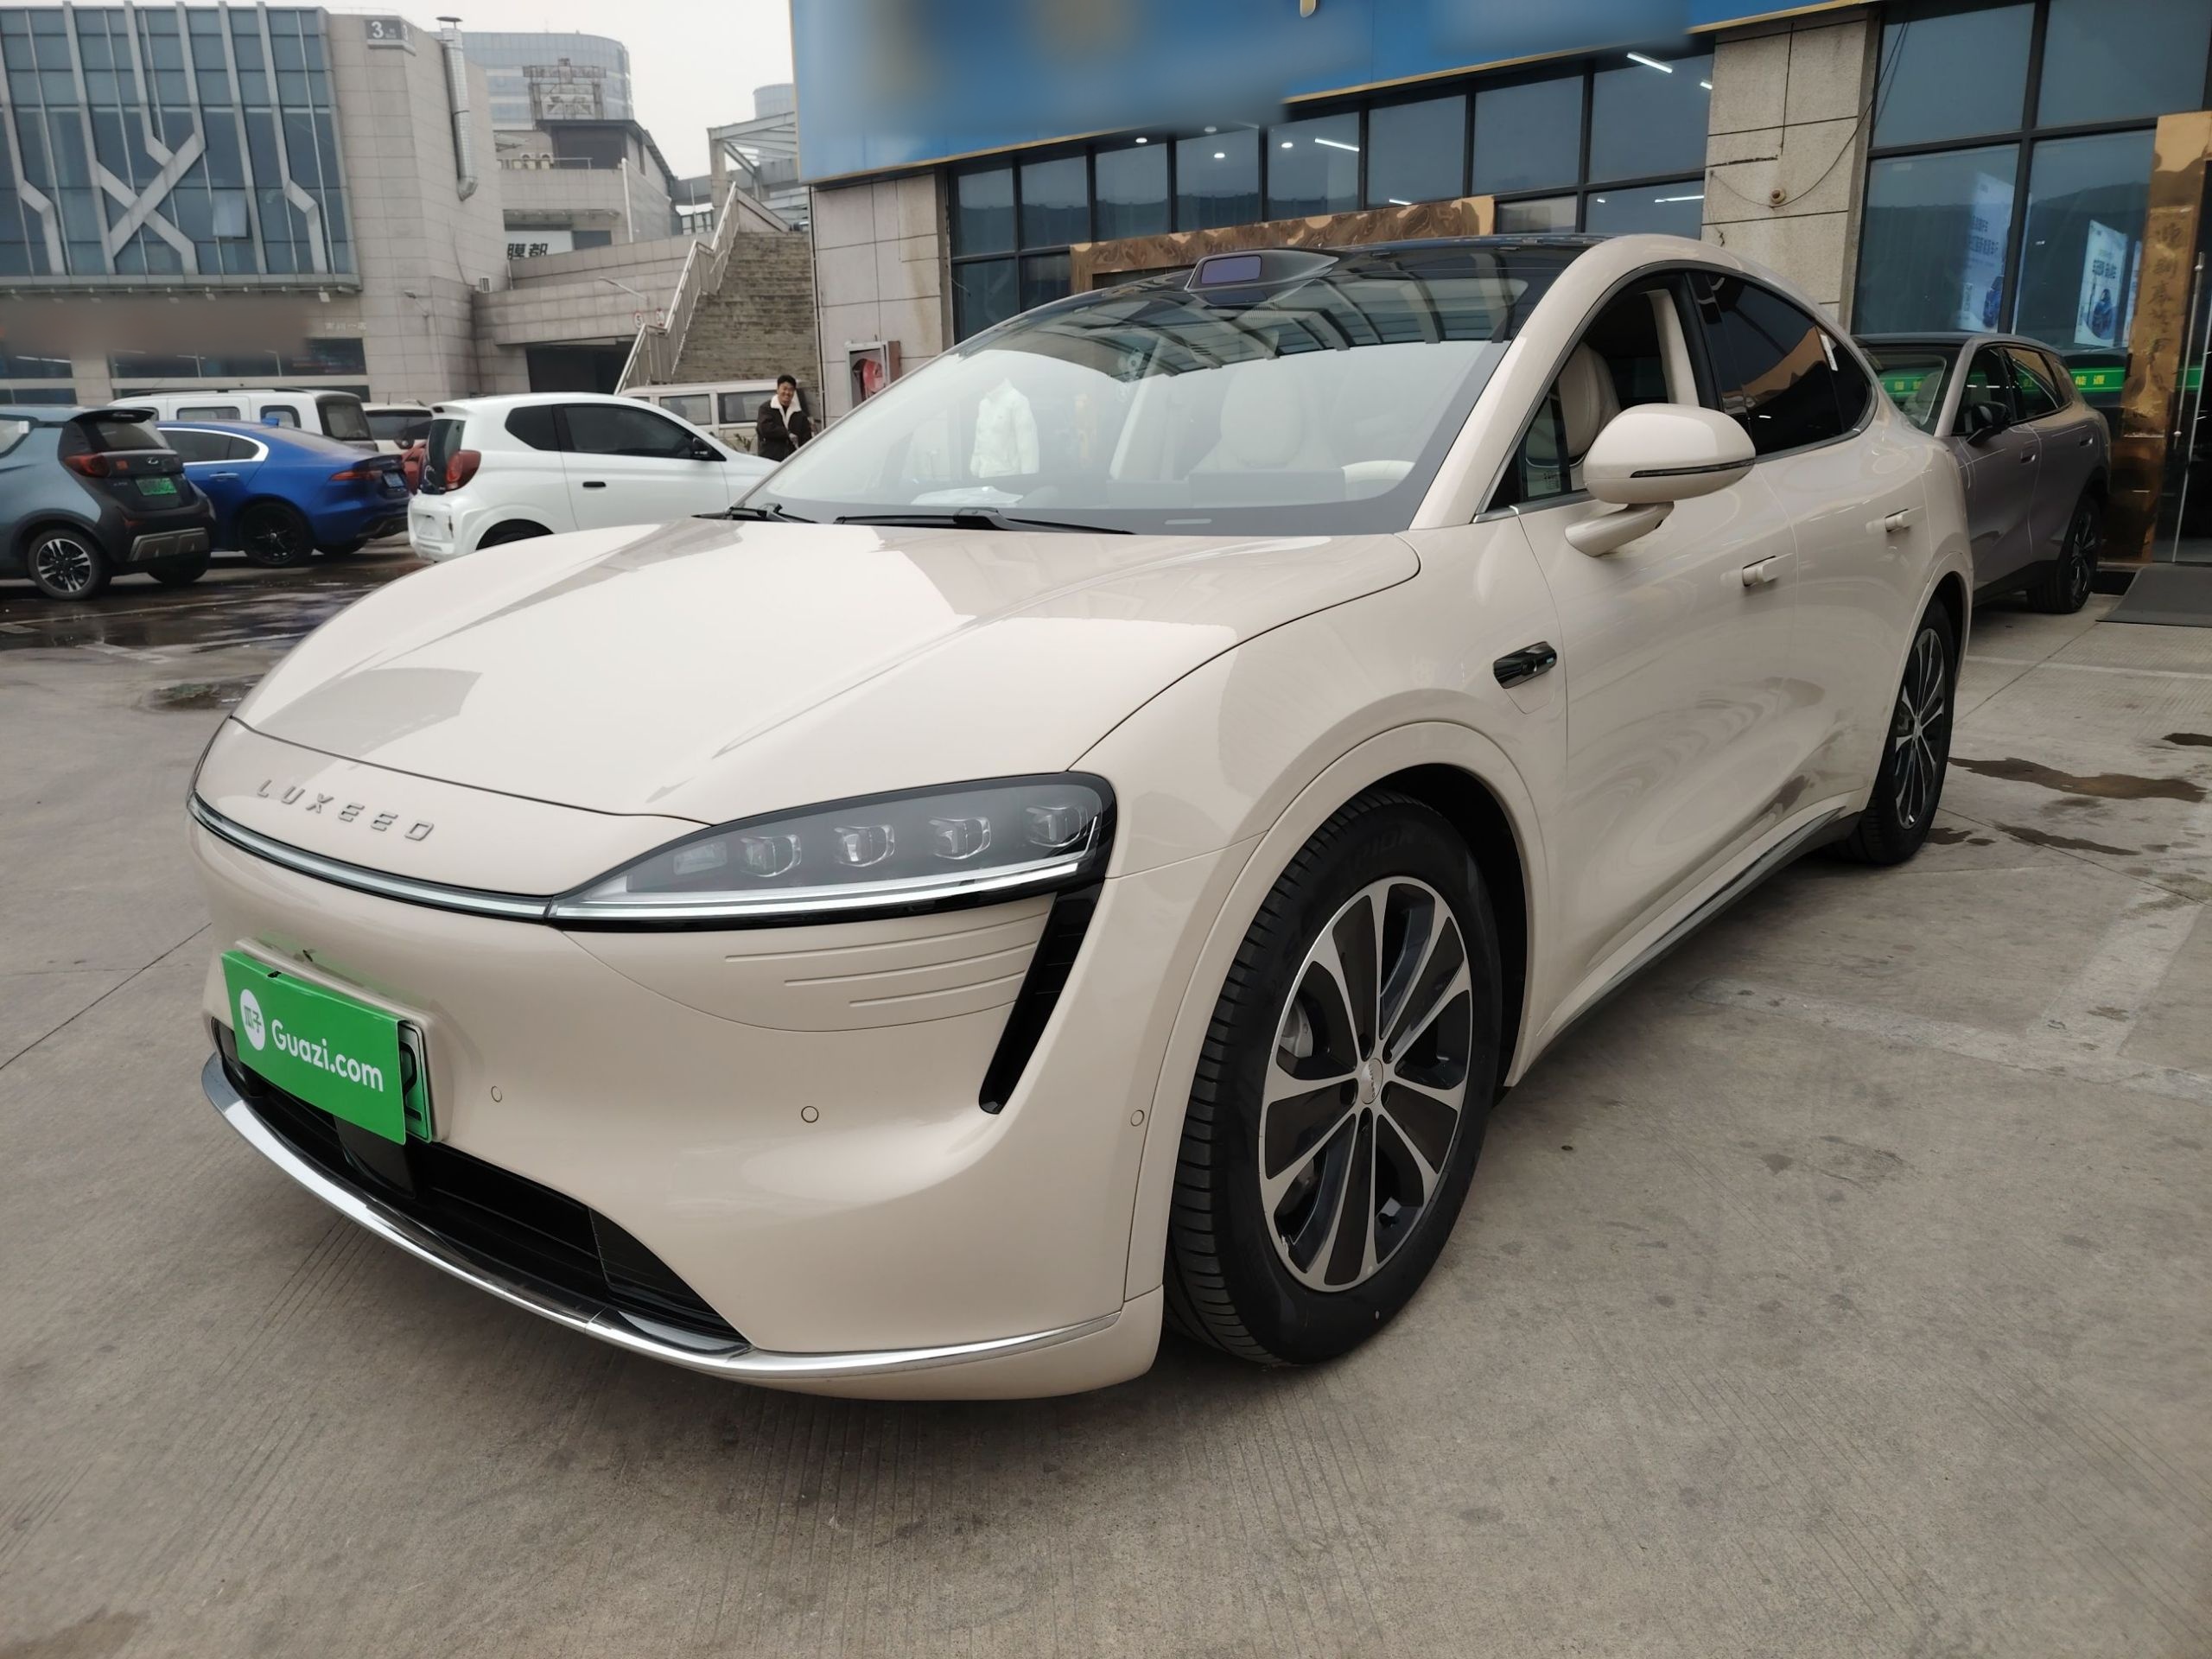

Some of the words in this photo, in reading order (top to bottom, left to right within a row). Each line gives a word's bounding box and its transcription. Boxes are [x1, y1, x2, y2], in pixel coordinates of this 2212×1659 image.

[372, 21, 384, 39] 3
[257, 779, 435, 842] LUXEED
[244, 1005, 262, 1033] 瓜子
[271, 1019, 384, 1092] Guazi.com
